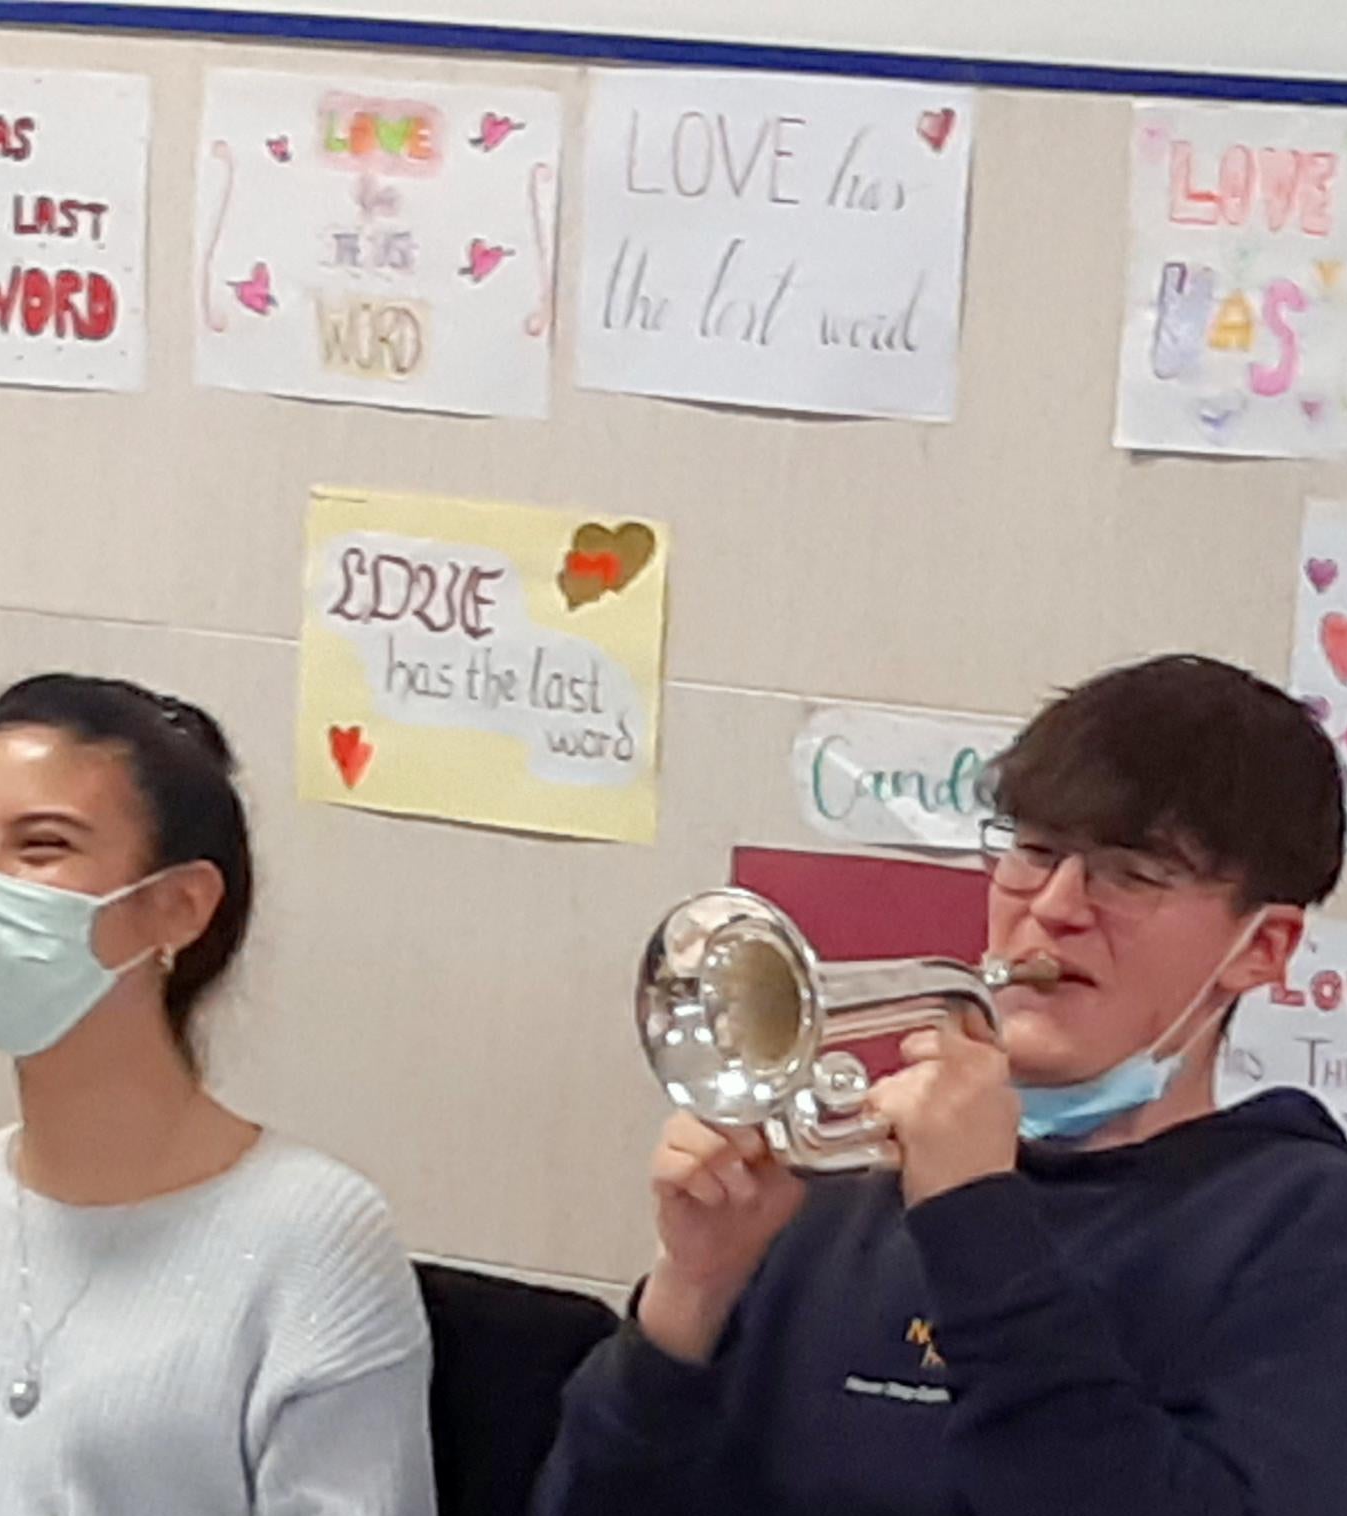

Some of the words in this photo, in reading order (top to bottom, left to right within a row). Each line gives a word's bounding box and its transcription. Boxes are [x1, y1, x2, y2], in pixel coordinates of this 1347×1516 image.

[626, 109, 807, 206] LOVE
[1168, 139, 1340, 237] LOVE
[13, 194, 109, 241] LAST
[384, 636, 454, 701] has
[466, 648, 519, 708] the
[528, 647, 604, 714] last
[544, 712, 636, 762] word
